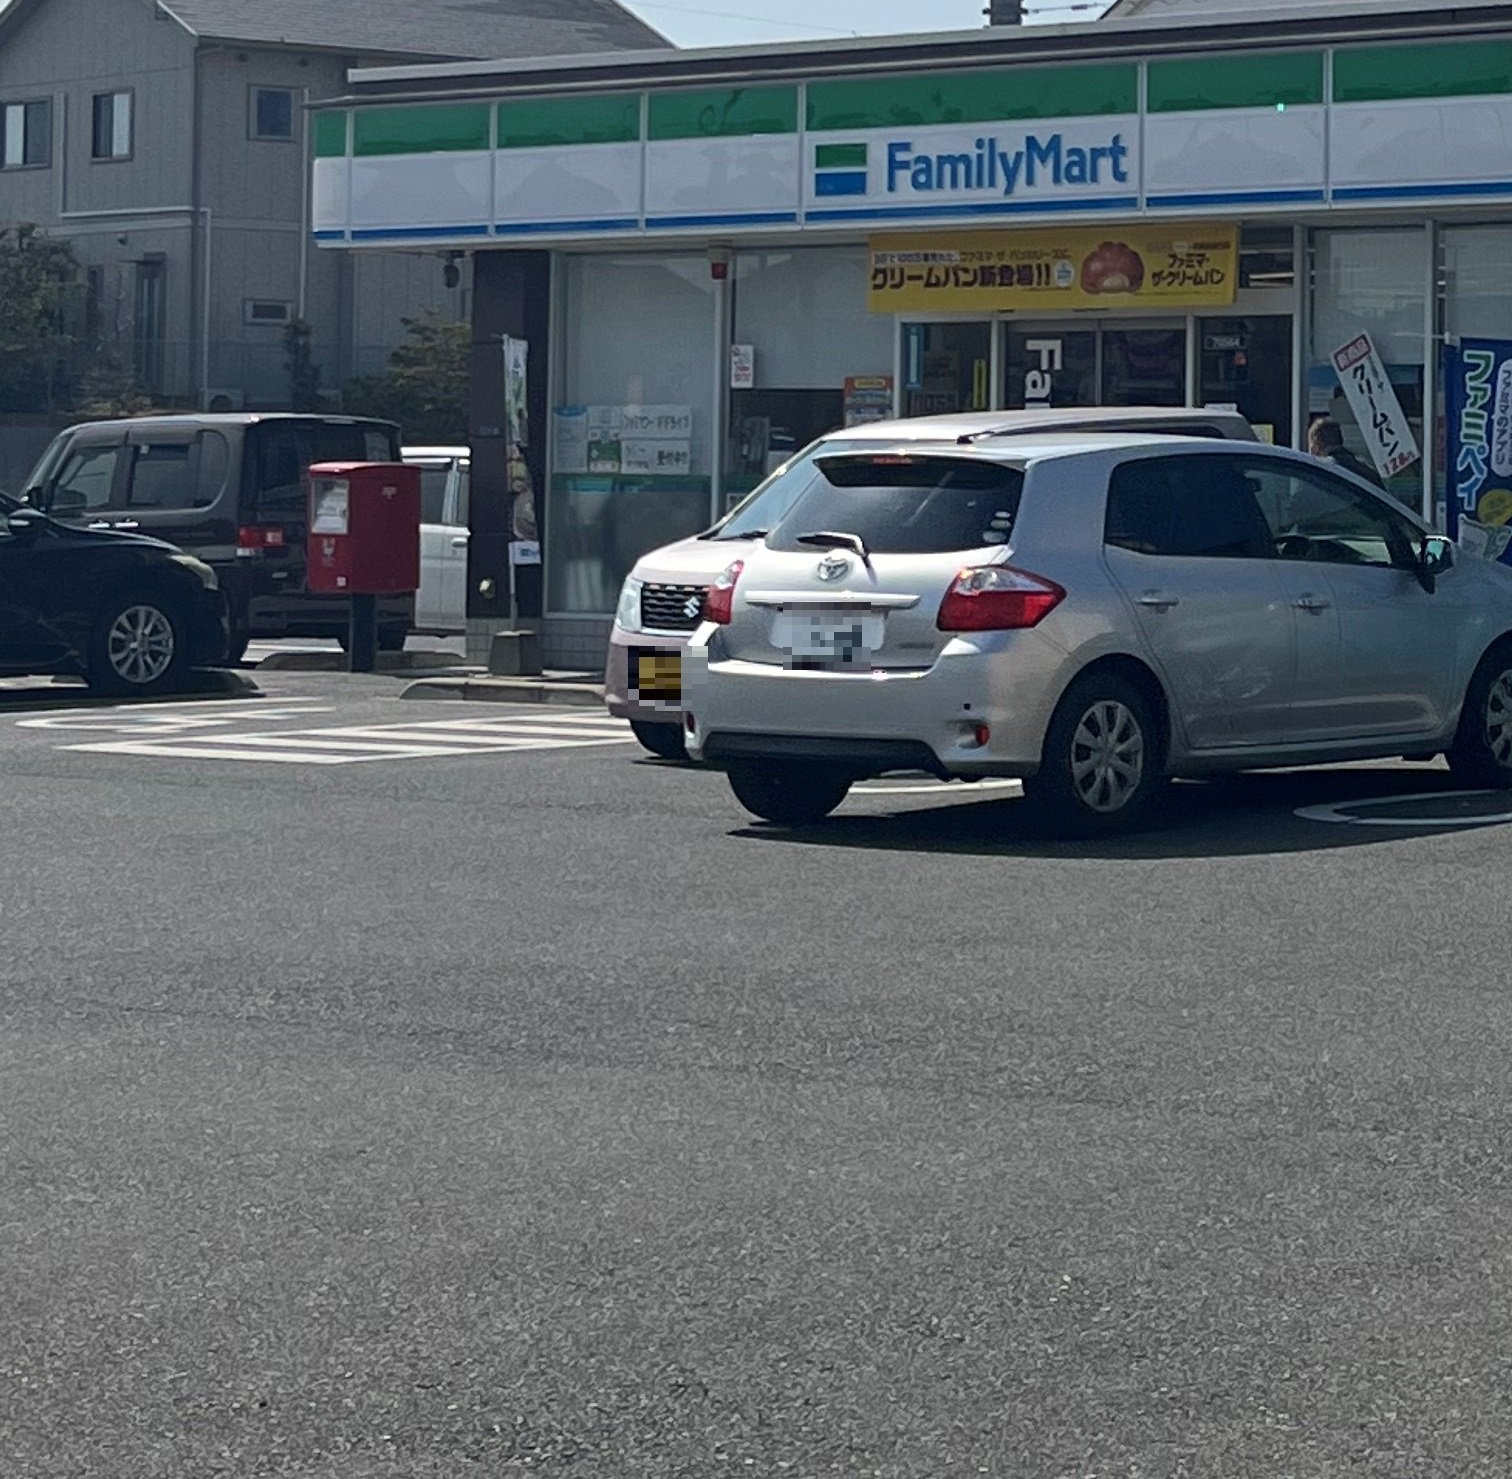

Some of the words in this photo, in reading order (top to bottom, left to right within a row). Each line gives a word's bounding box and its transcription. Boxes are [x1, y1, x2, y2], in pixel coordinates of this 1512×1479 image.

[887, 132, 1127, 196] FamilyMart
[1352, 364, 1400, 457] クリームパン
[1457, 350, 1495, 513] ファミペイ
